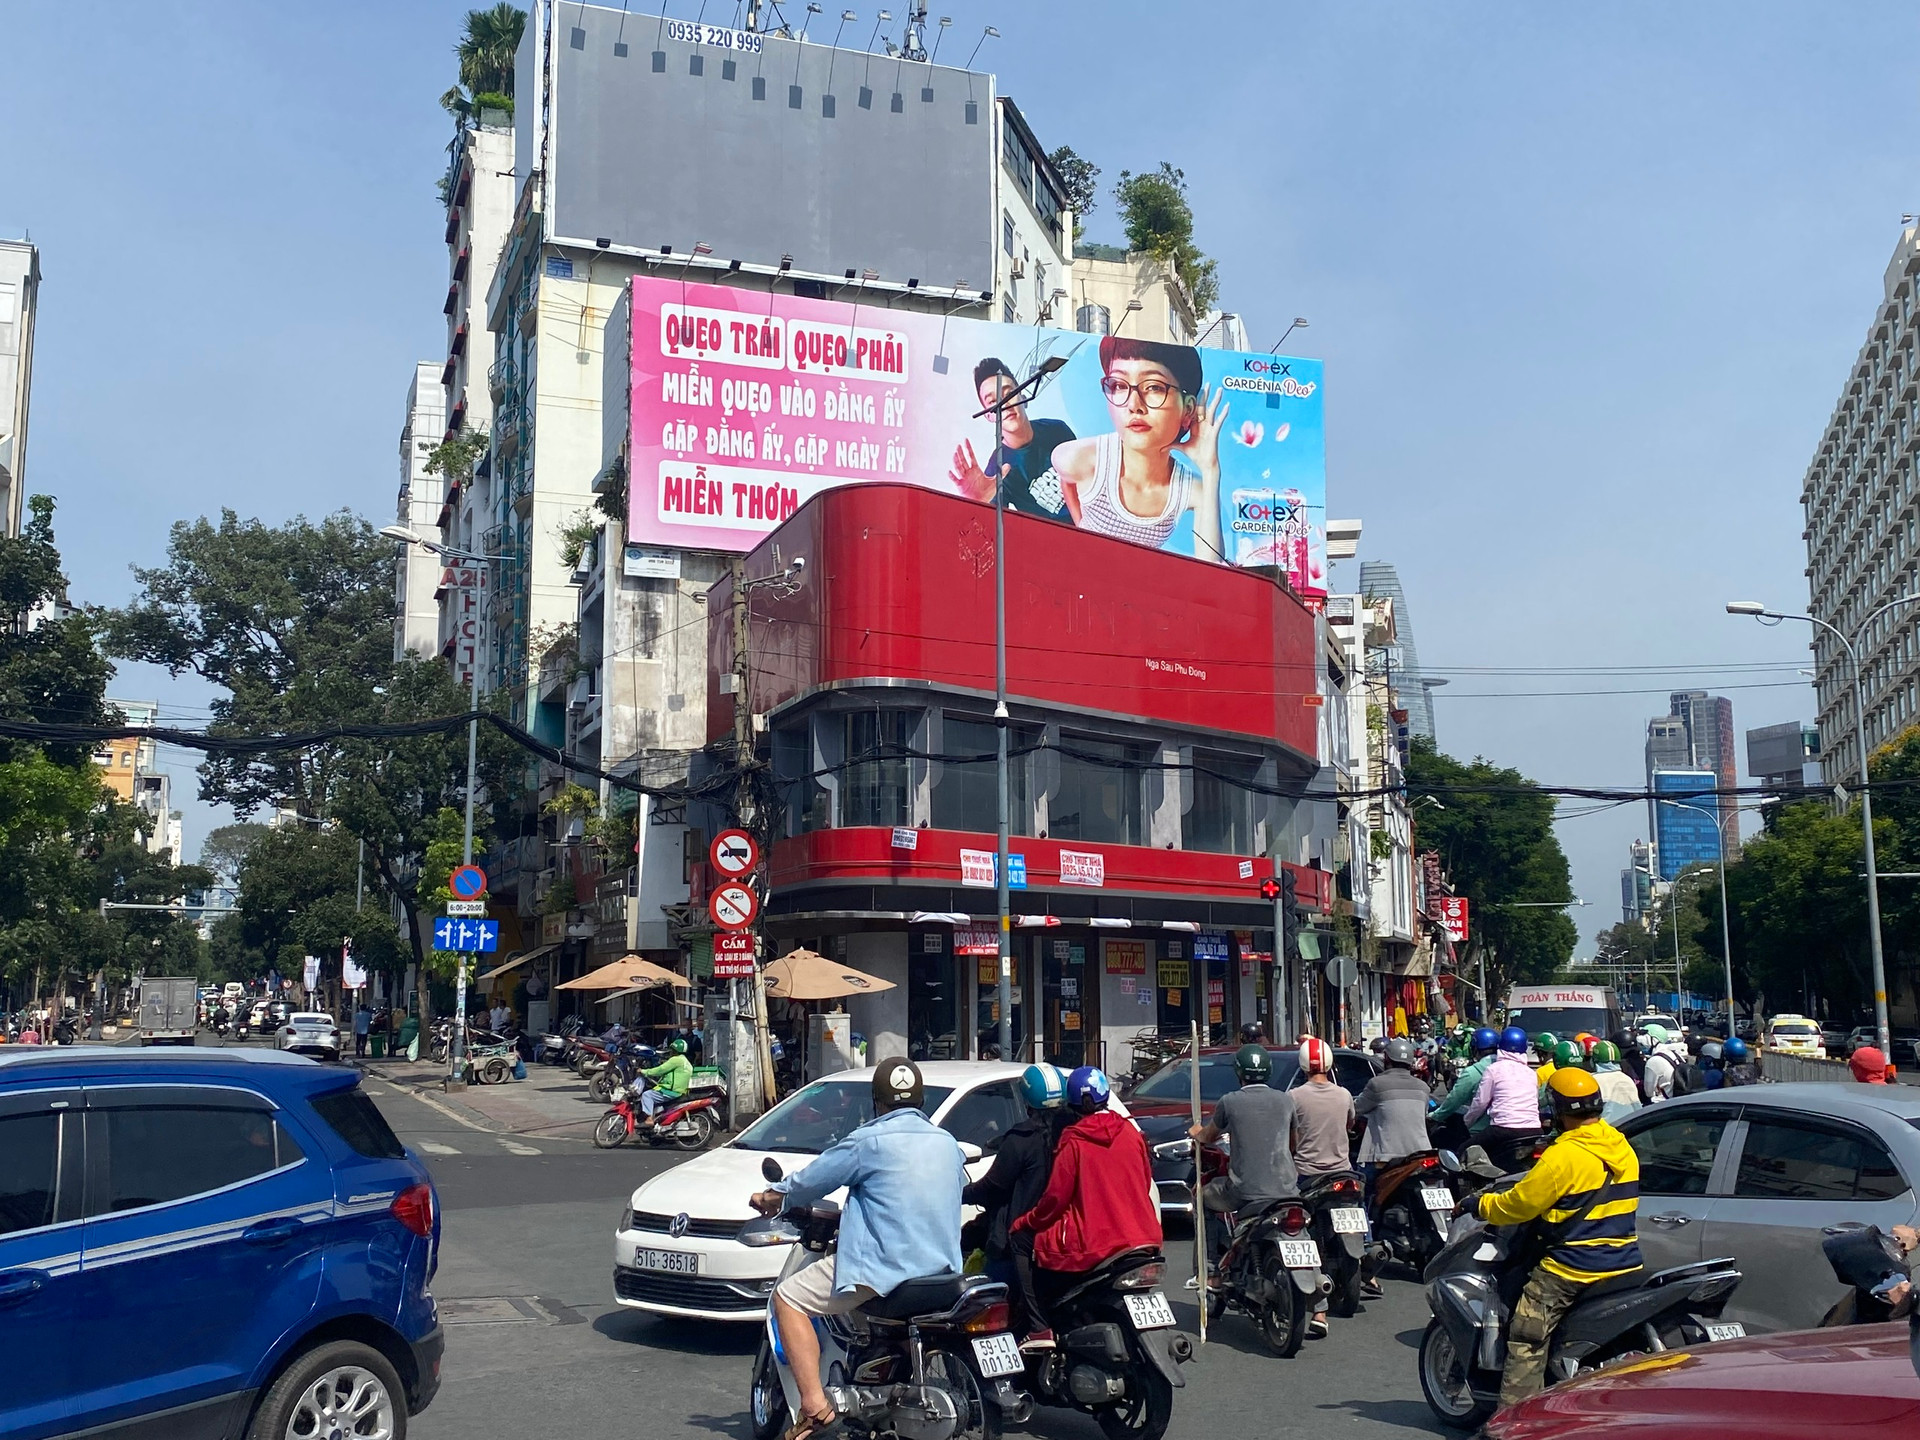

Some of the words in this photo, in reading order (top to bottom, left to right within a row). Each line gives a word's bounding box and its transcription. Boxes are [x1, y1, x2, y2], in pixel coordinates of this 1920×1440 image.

[668, 22, 702, 43] 0935
[707, 28, 732, 48] 220
[737, 32, 761, 53] 999
[666, 314, 722, 358] QUẸO
[730, 318, 780, 359] TRÁI
[794, 330, 846, 373] QUẸO
[856, 333, 903, 374] PHẢI
[721, 378, 772, 418] QUẸO
[779, 380, 816, 418] VÀO
[824, 382, 876, 425] ĐẰNG
[883, 387, 906, 428] ẤY
[662, 419, 698, 459] GẶP
[705, 418, 755, 459] ĐẰNG
[794, 433, 829, 472] GẶP
[835, 436, 880, 471] NGÀY
[885, 435, 906, 473] ẤY
[732, 482, 798, 522] THƠM
[1233, 521, 1284, 533] GARDÉNA
[440, 568, 486, 588] A25
[1145, 658, 1160, 671] Nga
[1160, 660, 1174, 672] Sau
[1174, 663, 1188, 675] Phu
[721, 935, 747, 950] CẤM
[1521, 992, 1550, 1003] TOÀN
[1568, 1055, 1583, 1063] Grab
[1131, 1295, 1162, 1311] 59-K1
[979, 1336, 1011, 1356] 59-L1
[981, 1353, 1020, 1375] 001.38
